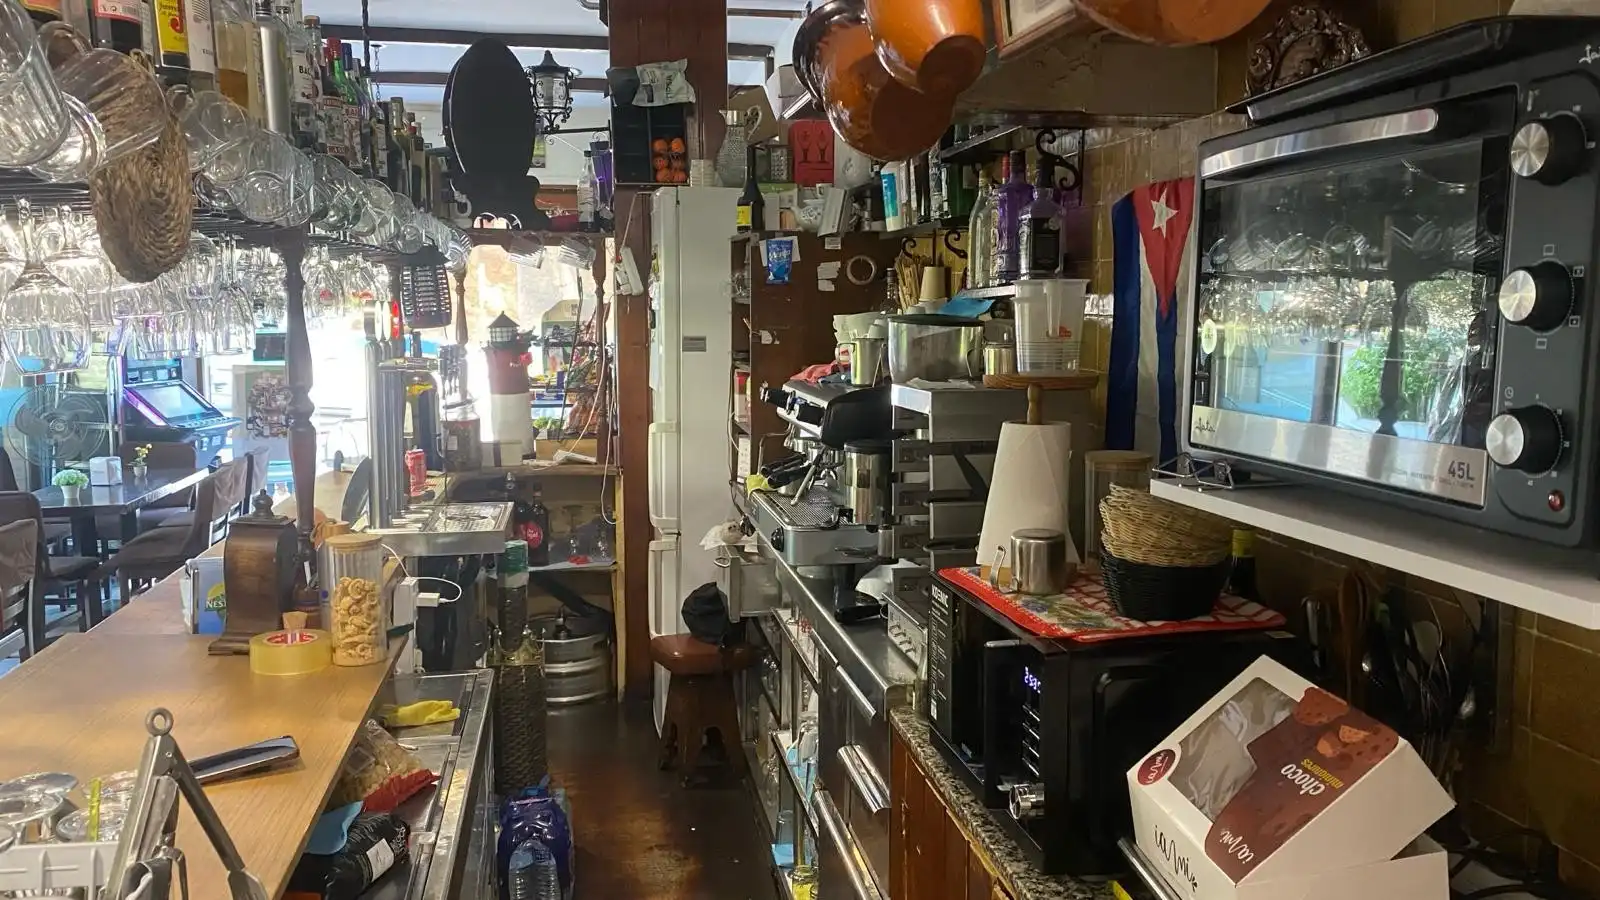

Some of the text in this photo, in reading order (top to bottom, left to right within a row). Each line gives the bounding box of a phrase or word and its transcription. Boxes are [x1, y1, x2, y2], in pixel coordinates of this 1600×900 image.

[1578, 43, 1600, 64] Ja
[1447, 460, 1476, 481] 45L
[1280, 763, 1326, 796] choco
[1300, 758, 1345, 789] miniatures
